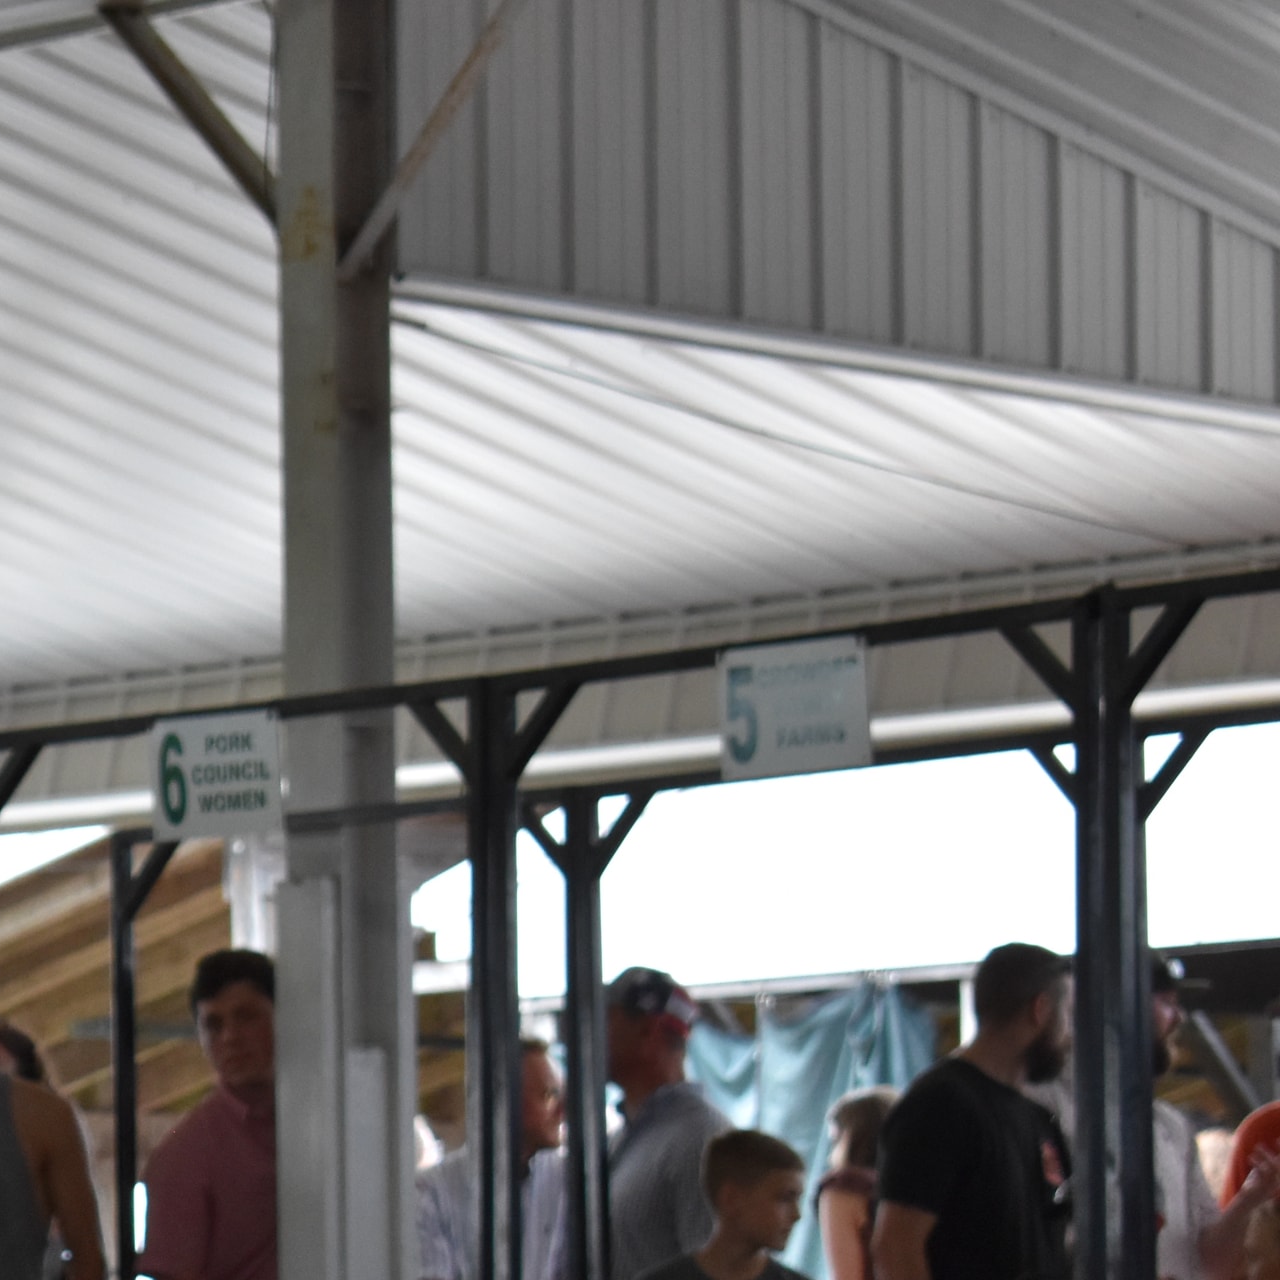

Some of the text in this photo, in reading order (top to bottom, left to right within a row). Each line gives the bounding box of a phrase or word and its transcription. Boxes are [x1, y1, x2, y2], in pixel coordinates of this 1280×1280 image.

[726, 665, 758, 765] 5
[204, 730, 252, 754] PORK
[159, 732, 187, 827] 6
[191, 759, 271, 786] COUNCIL
[197, 788, 268, 813] WOMEN
